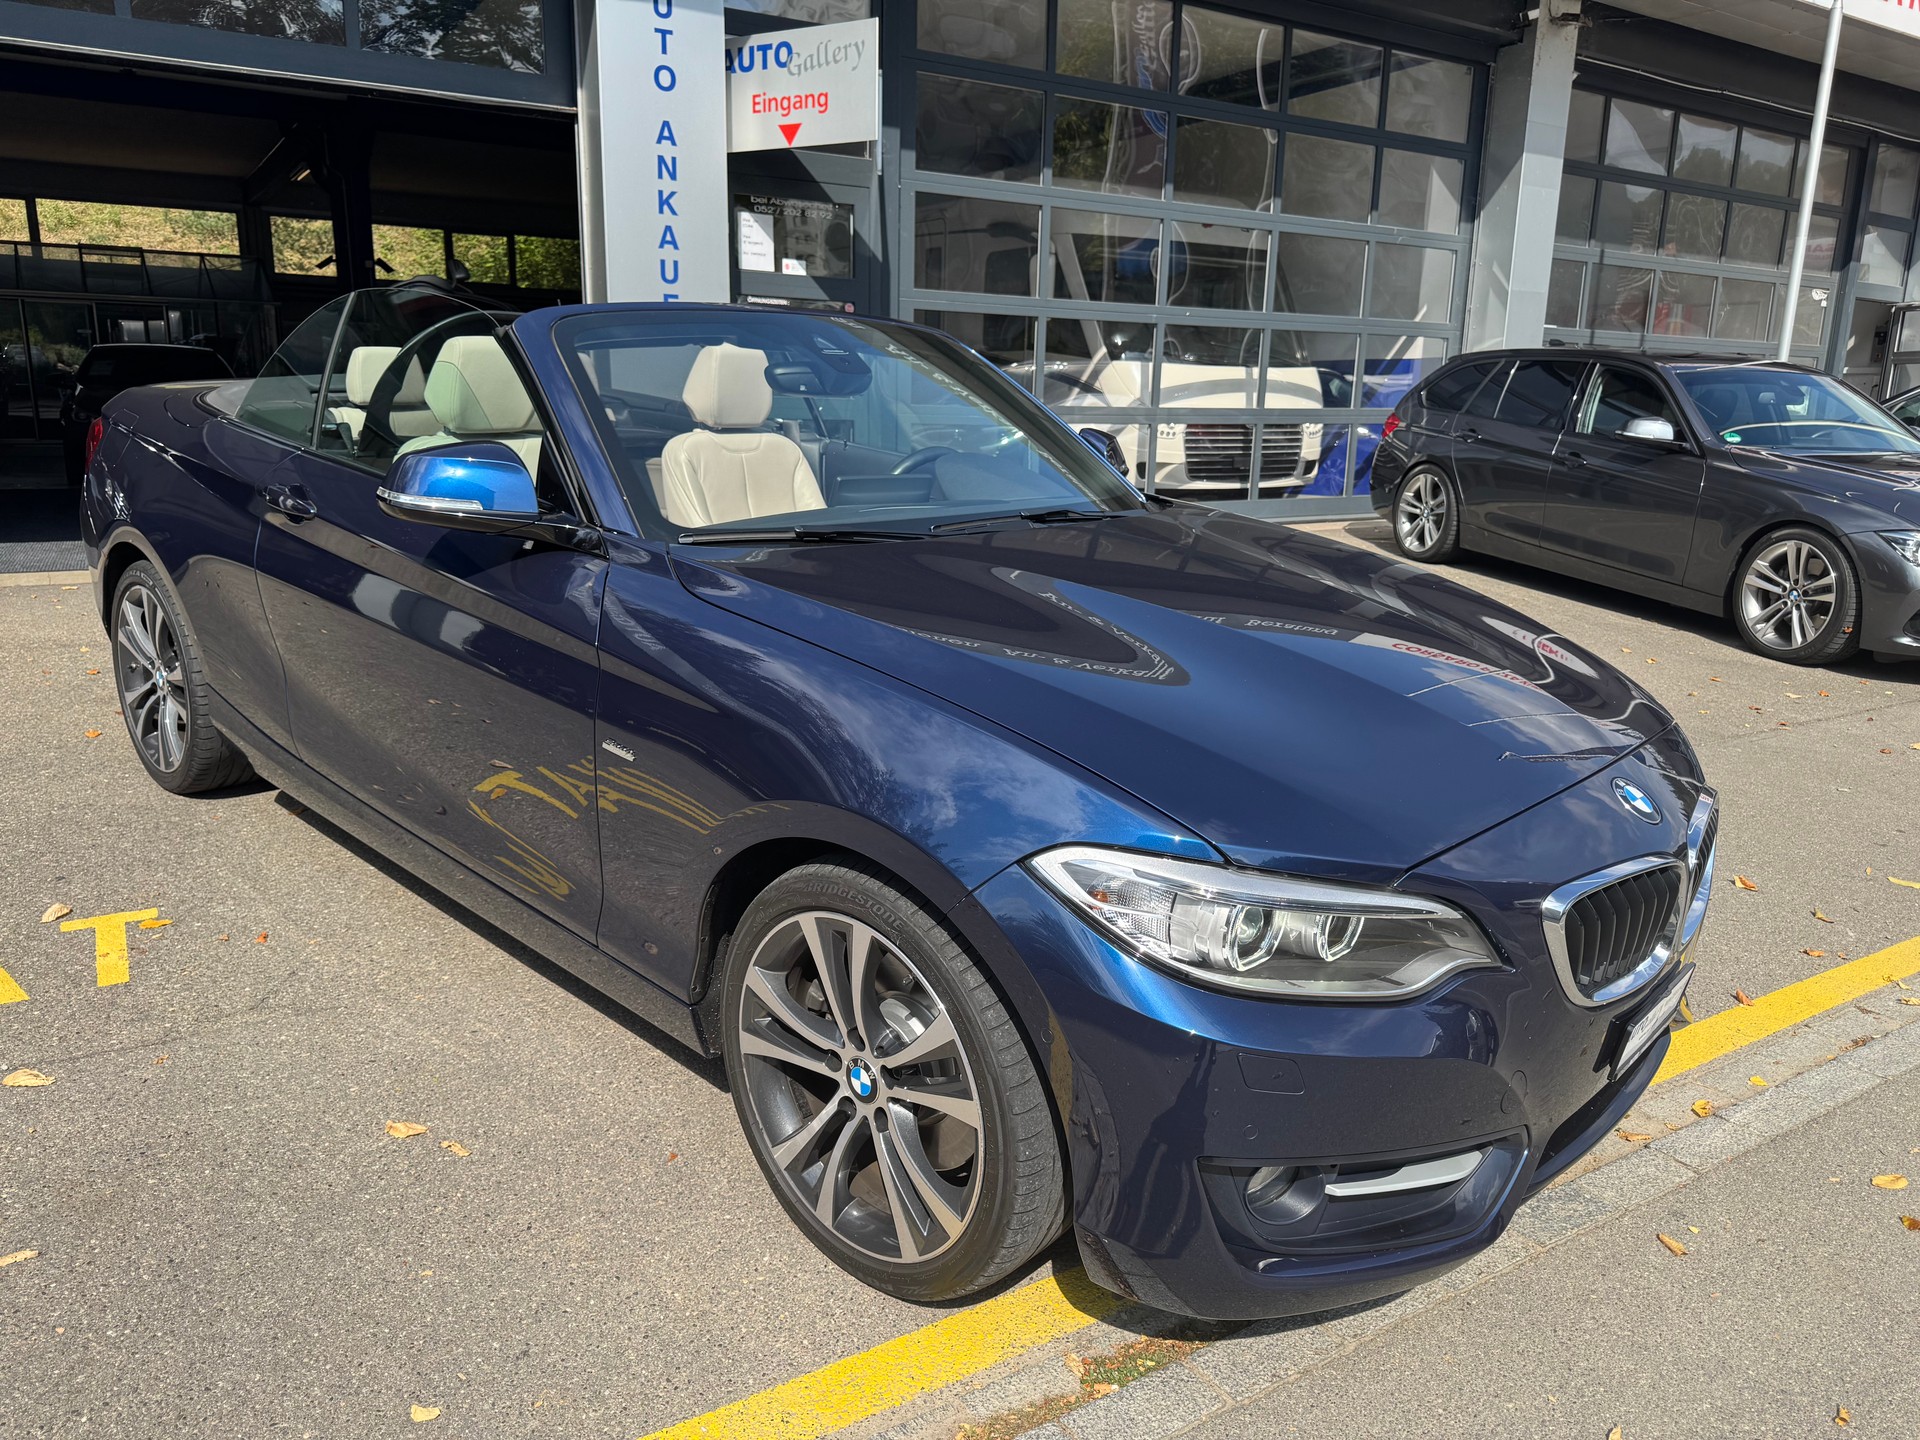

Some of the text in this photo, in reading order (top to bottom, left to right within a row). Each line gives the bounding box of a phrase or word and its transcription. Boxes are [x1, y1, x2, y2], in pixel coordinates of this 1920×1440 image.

[726, 39, 865, 77] AUTO Gallery
[752, 92, 829, 117] Eingang
[656, 120, 680, 303] ANKAU
[783, 207, 802, 217] 202
[802, 881, 905, 931] BRIDGESTONE
